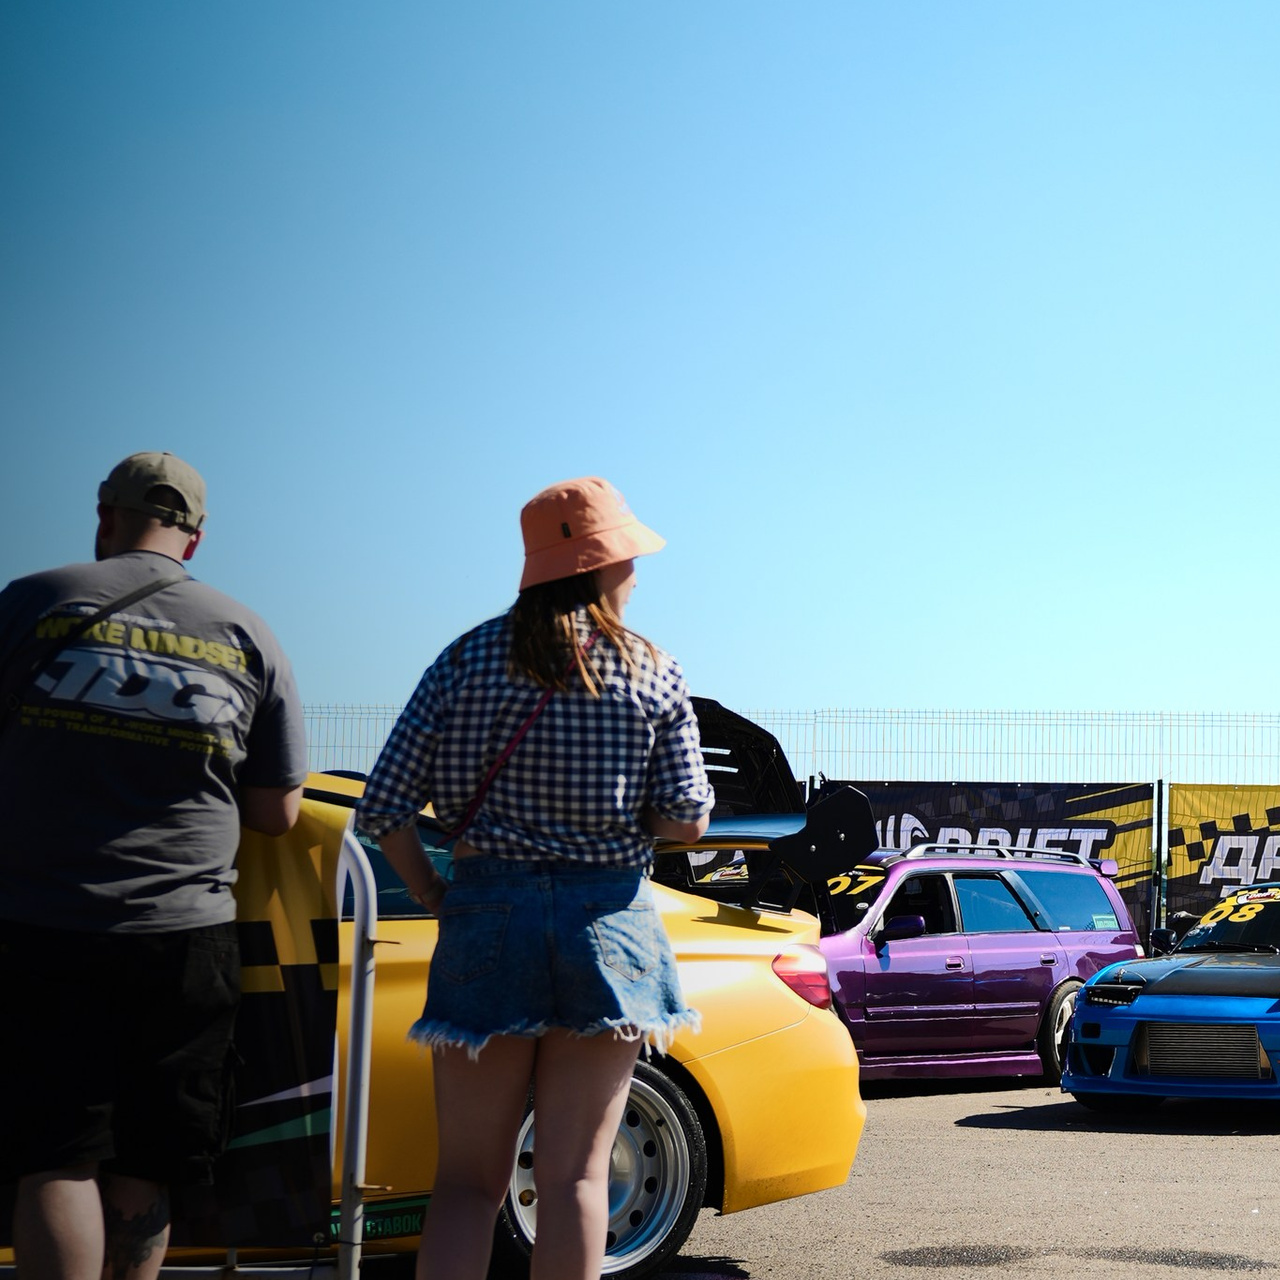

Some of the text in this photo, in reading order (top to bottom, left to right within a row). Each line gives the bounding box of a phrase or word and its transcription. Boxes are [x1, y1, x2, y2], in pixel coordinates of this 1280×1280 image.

[90, 714, 107, 723] OF
[1200, 903, 1265, 925] 08
[366, 1213, 422, 1237] СТАВОК
